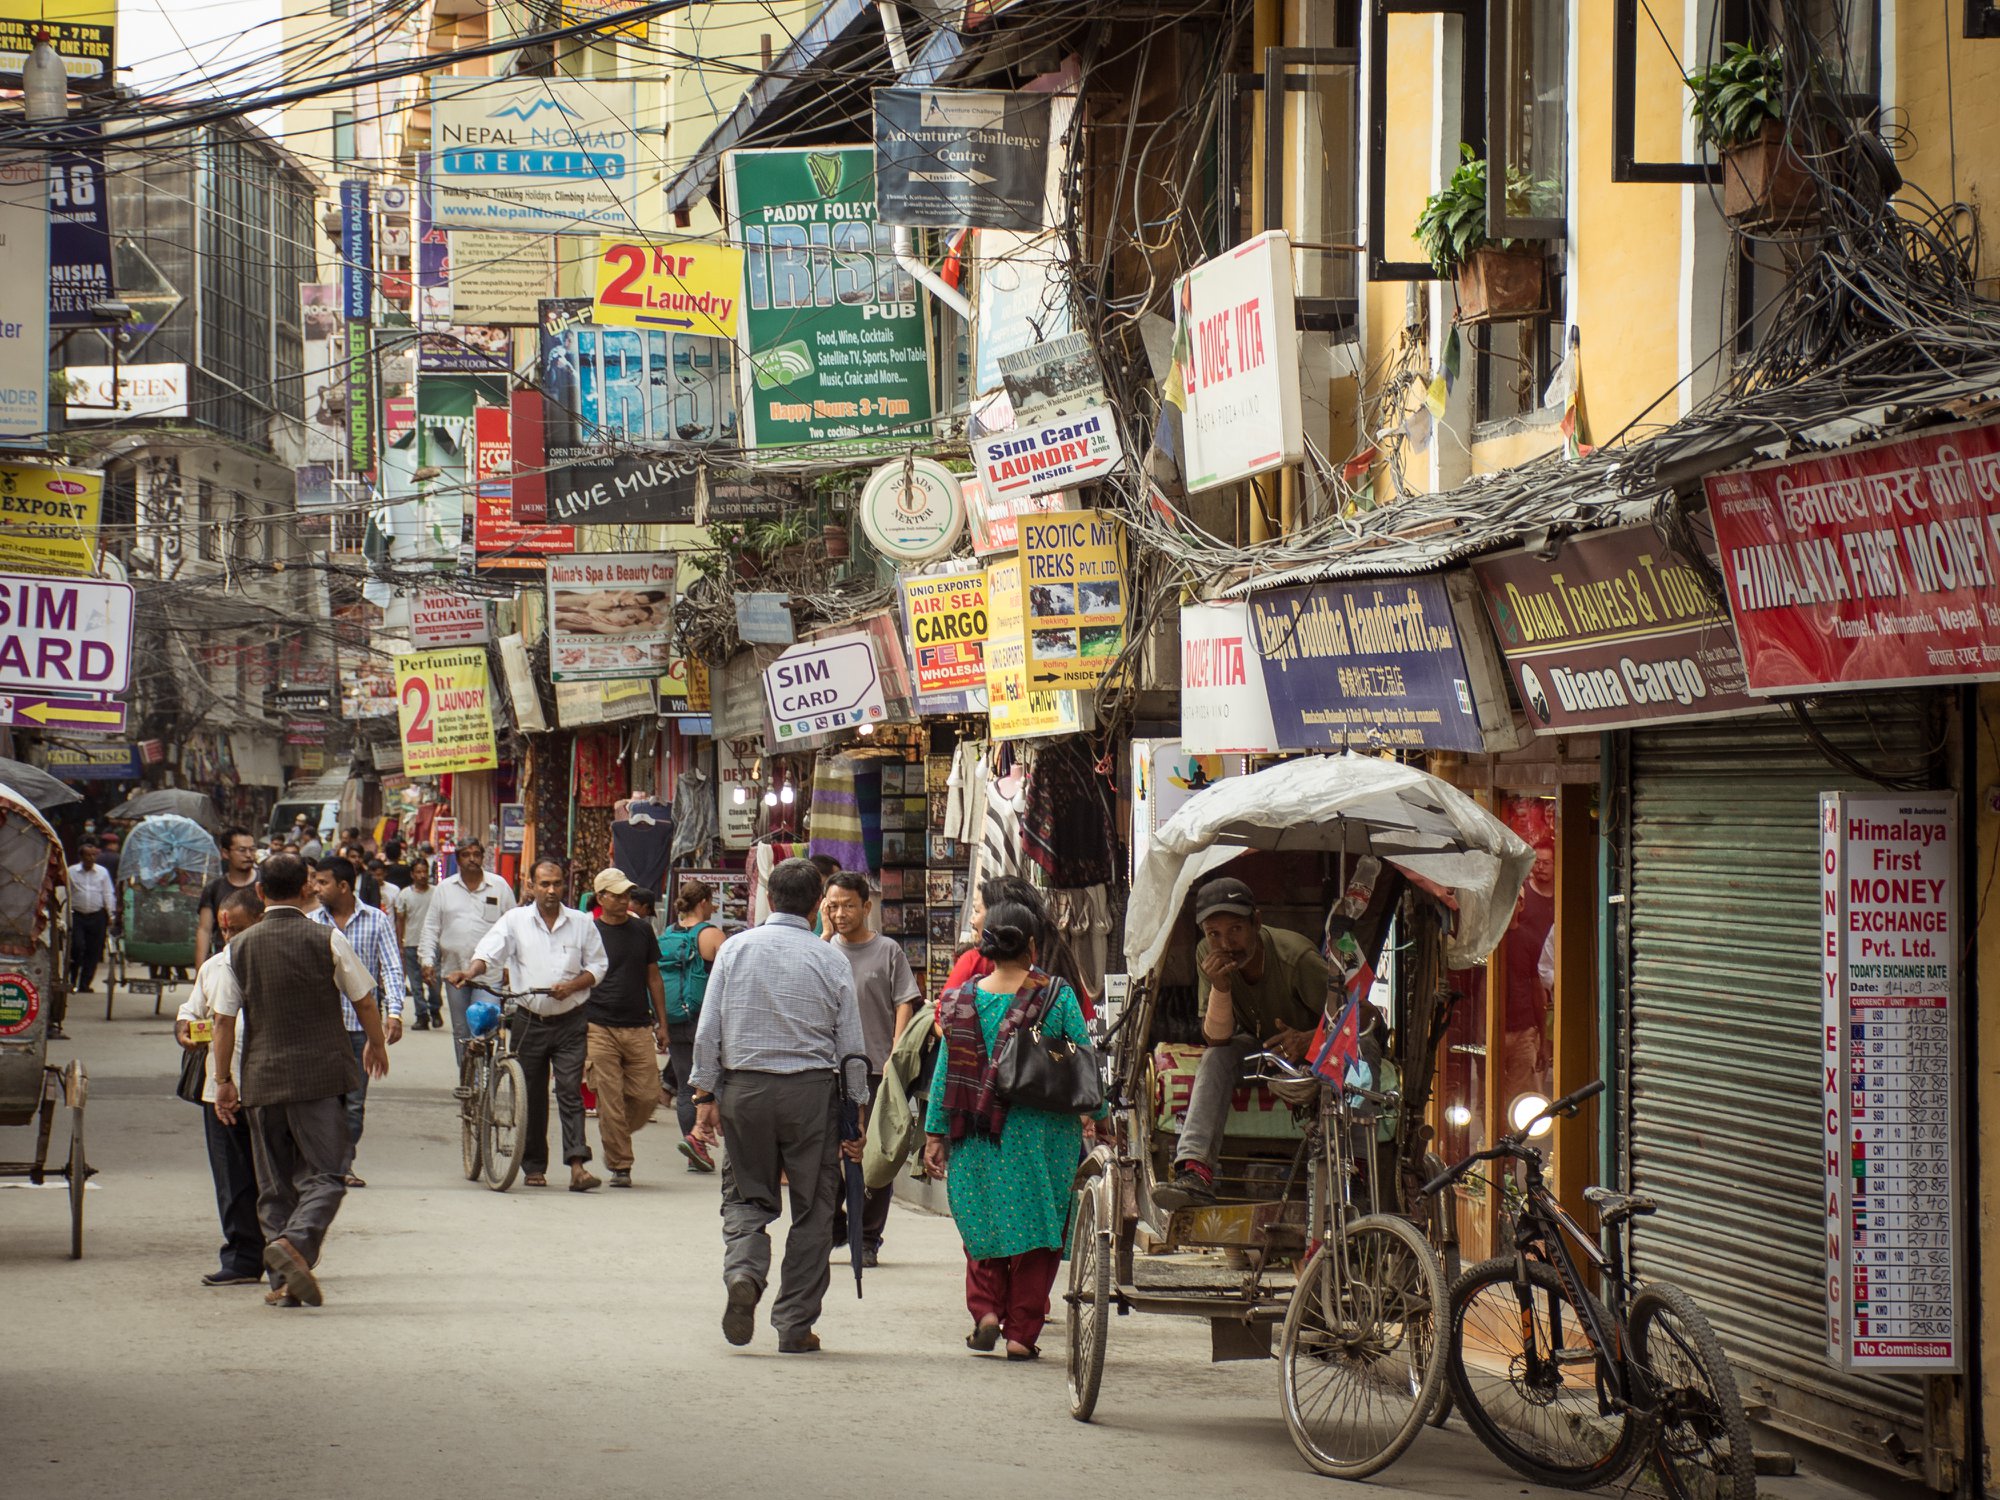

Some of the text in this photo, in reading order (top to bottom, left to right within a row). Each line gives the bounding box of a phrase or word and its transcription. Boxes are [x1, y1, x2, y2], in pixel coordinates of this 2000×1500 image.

[81, 28, 100, 40] PM
[60, 40, 109, 57] ONE FREE
[442, 124, 626, 149] NEPAL NOMAD
[885, 129, 1041, 151] Adventure Challenge
[454, 153, 617, 176] TREKKING
[937, 148, 986, 163] Centre
[51, 165, 95, 206] 48
[493, 187, 524, 205] Trekking
[554, 190, 585, 204] Climbing
[443, 204, 626, 223] www.NepalNomad.Com
[763, 204, 817, 222] PADDY
[653, 245, 695, 277] hr
[745, 219, 917, 310] IRISH
[600, 243, 647, 308] 2
[646, 285, 733, 321] Laundry
[863, 302, 917, 321] PUB
[817, 328, 895, 346] Food, Wine, Cocktails
[1200, 308, 1232, 389] DOLCE
[1235, 297, 1265, 373] VITA
[350, 322, 368, 385] STREET
[818, 350, 850, 367] Satellite
[849, 350, 863, 366] TV,
[862, 350, 891, 366] Sports,
[890, 348, 908, 363] Pool
[999, 343, 1057, 374] GLOBAL FASHION
[98, 378, 178, 402] QUEEN
[819, 370, 880, 388] Music, Craic and
[1073, 391, 1084, 401] and
[769, 401, 812, 424] Happy
[813, 400, 859, 420] Hours:
[351, 388, 368, 470] MANDALA
[809, 427, 825, 439] Two
[827, 425, 861, 439] cocktails
[987, 416, 1101, 461] Sim Card
[549, 448, 568, 458] OPEN
[988, 438, 1089, 483] LAUNDRY
[890, 476, 933, 493] NOADS
[1032, 465, 1074, 484] INSIDE
[555, 461, 698, 518] LIVE MUSIC
[2, 495, 87, 519] EXPORT
[1776, 474, 1870, 534] हिमालय
[1026, 521, 1117, 550] EXOTIC MT.
[552, 564, 674, 586] Alina's Spa & Beauty Care
[1028, 553, 1120, 579] TREKS PVT. LTD.
[1732, 516, 1996, 612] HIMALAYA FIRST MONEY
[910, 585, 935, 597] UNIO
[937, 578, 983, 594] EXPORTS
[0, 583, 79, 632] SIM
[423, 597, 469, 610] MONEY
[951, 591, 985, 610] SEA
[1505, 568, 1659, 642] DIANA TRAVELS &
[413, 608, 484, 624] EXCHANGE
[916, 610, 988, 643] CARGO
[1040, 614, 1116, 625] Trekking Climbing
[1832, 602, 1984, 641] Thamel, Kathmandu, Nepal,
[556, 633, 673, 645] BODY THERAPY
[1254, 602, 1299, 672] Bajra
[1291, 596, 1351, 659] Buddha
[400, 653, 483, 672] Perfuming
[920, 642, 984, 668] FELT
[1043, 658, 1103, 670] Rafting Jungle
[1186, 636, 1246, 689] DOLCE VITA
[434, 673, 455, 691] hr
[777, 659, 830, 688] SIM
[1063, 671, 1095, 682] INSIDE
[1549, 666, 1629, 713] Diana
[1620, 656, 1707, 706] Cargo
[402, 676, 434, 745] 2
[436, 689, 485, 712] LAUNDRY
[782, 689, 838, 712] CARD
[438, 731, 490, 744] NO POWER CUT
[1849, 818, 1946, 847] Himalaya
[1873, 848, 1921, 871] First
[1824, 807, 1838, 998] MONEY
[1850, 878, 1946, 904] MONEY
[1850, 911, 1947, 932] EXCHANGE
[1862, 938, 1936, 957] Pvt. Ltd.
[1849, 964, 1947, 978] TODAY'S EXCHANGE RATE
[1850, 982, 1879, 993] Date:
[1852, 998, 1936, 1007] CURRENCY UNIT RATE
[1825, 1025, 1841, 1345] EXCHANGE
[1860, 1341, 1948, 1356] No Commission
